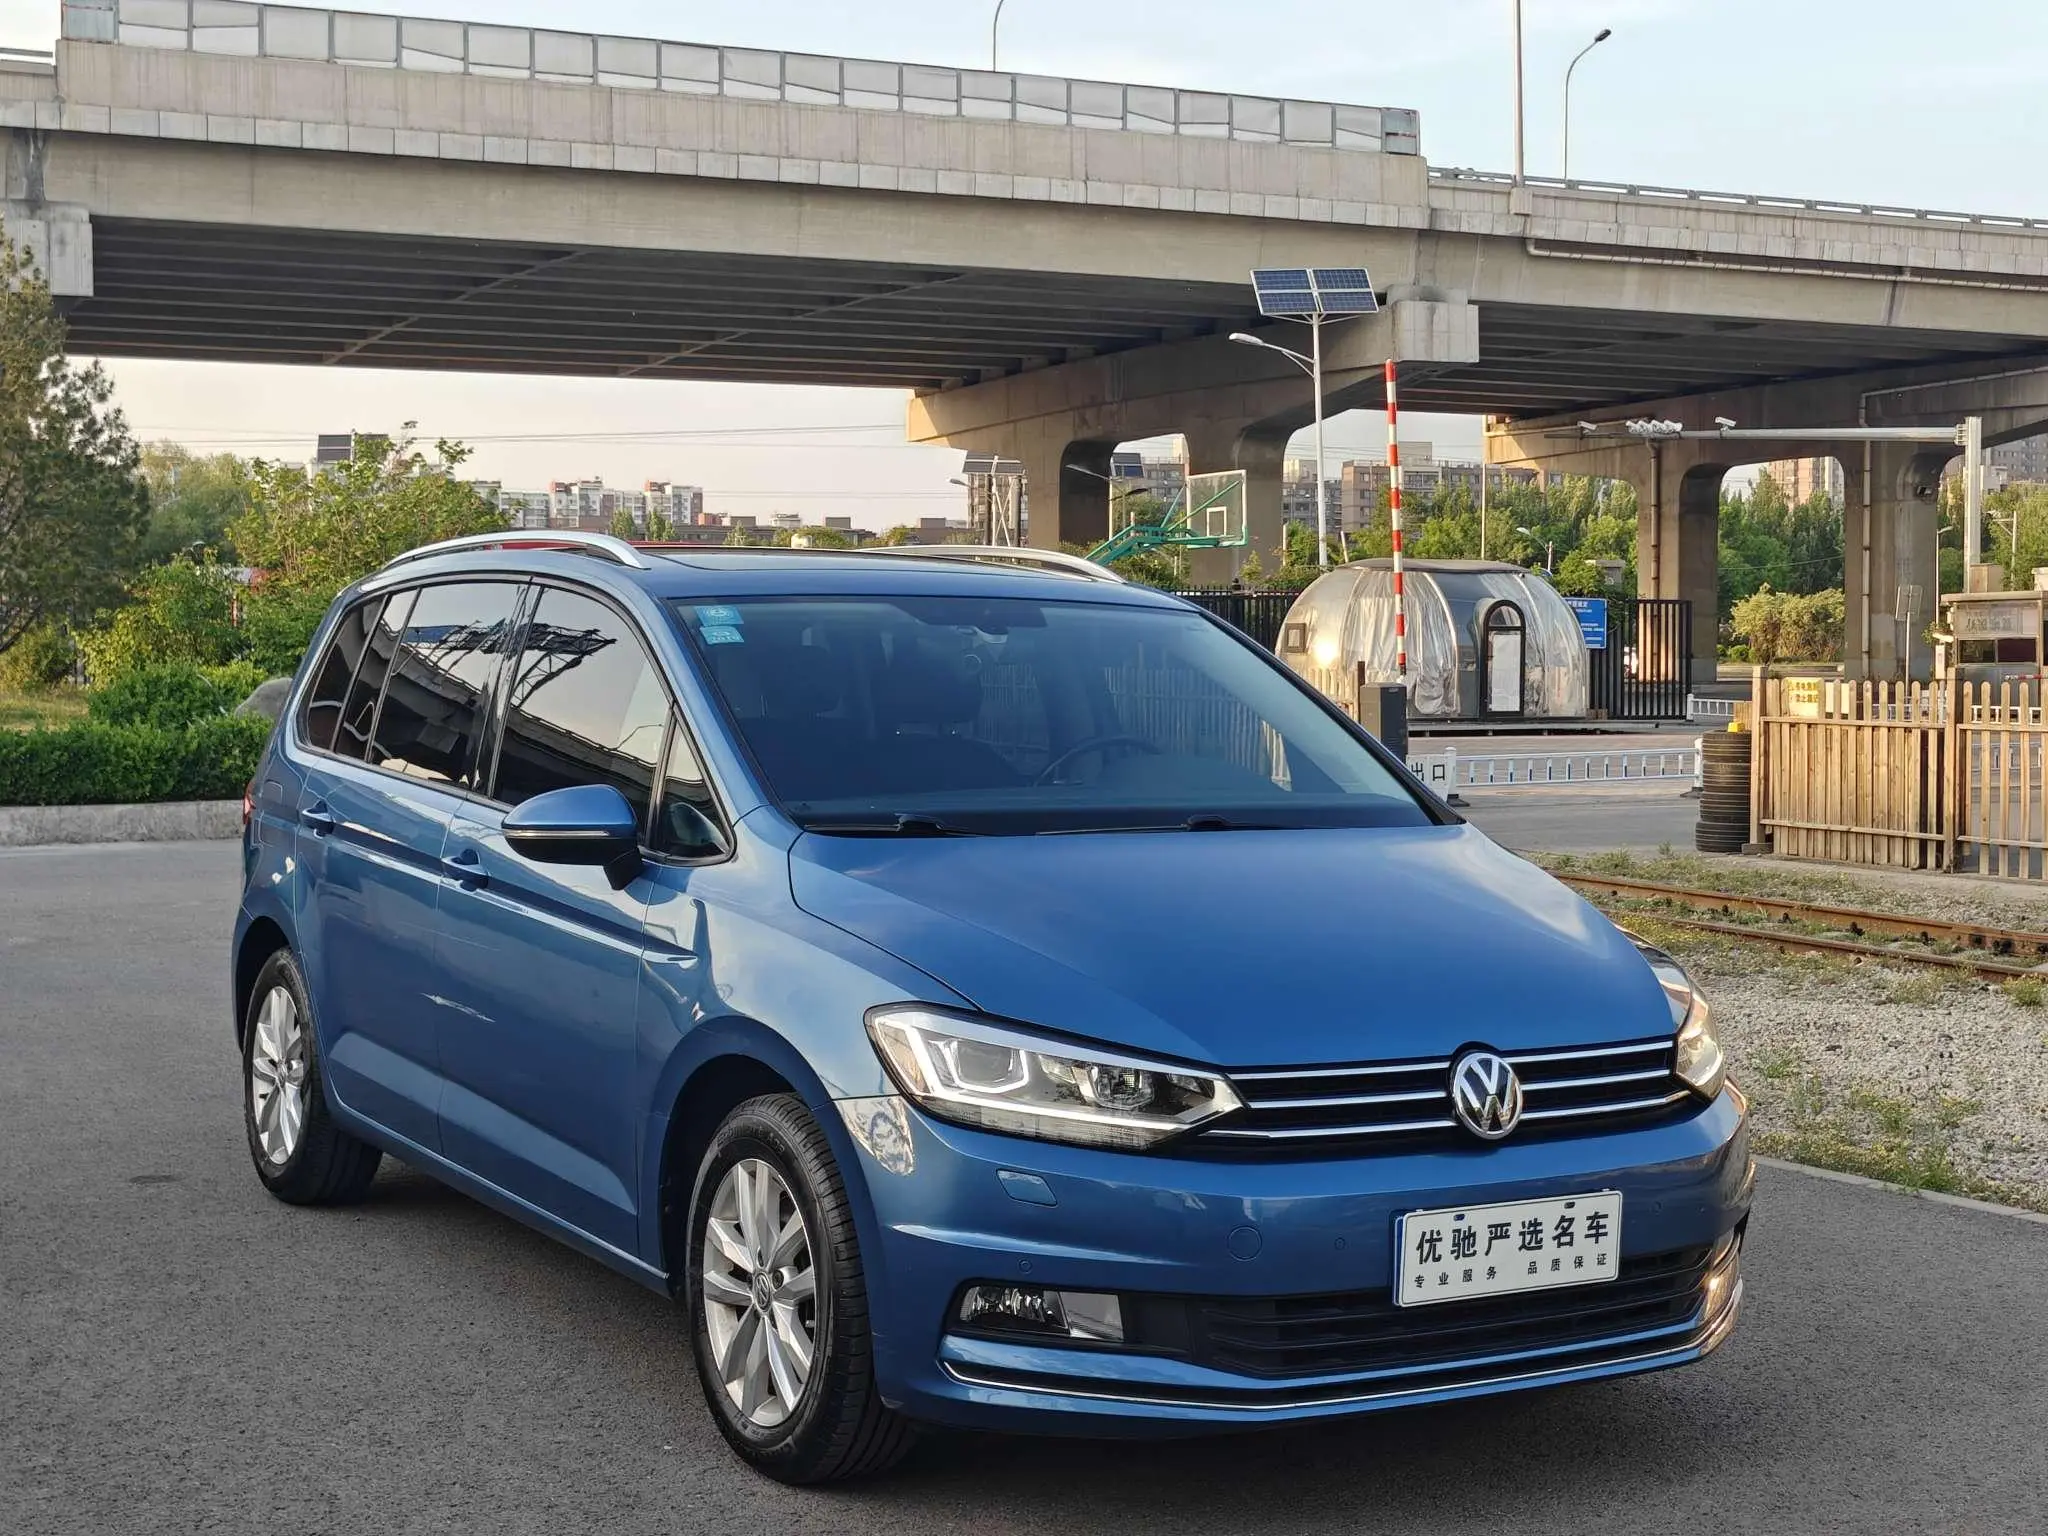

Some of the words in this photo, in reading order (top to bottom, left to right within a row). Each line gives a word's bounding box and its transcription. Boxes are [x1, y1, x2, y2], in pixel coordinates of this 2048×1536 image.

[1411, 762, 1445, 781] 出口
[1415, 1211, 1609, 1265] 优驰严选名车
[1414, 1266, 1497, 1288] 专业服务
[1527, 1253, 1608, 1275] 品质保证
